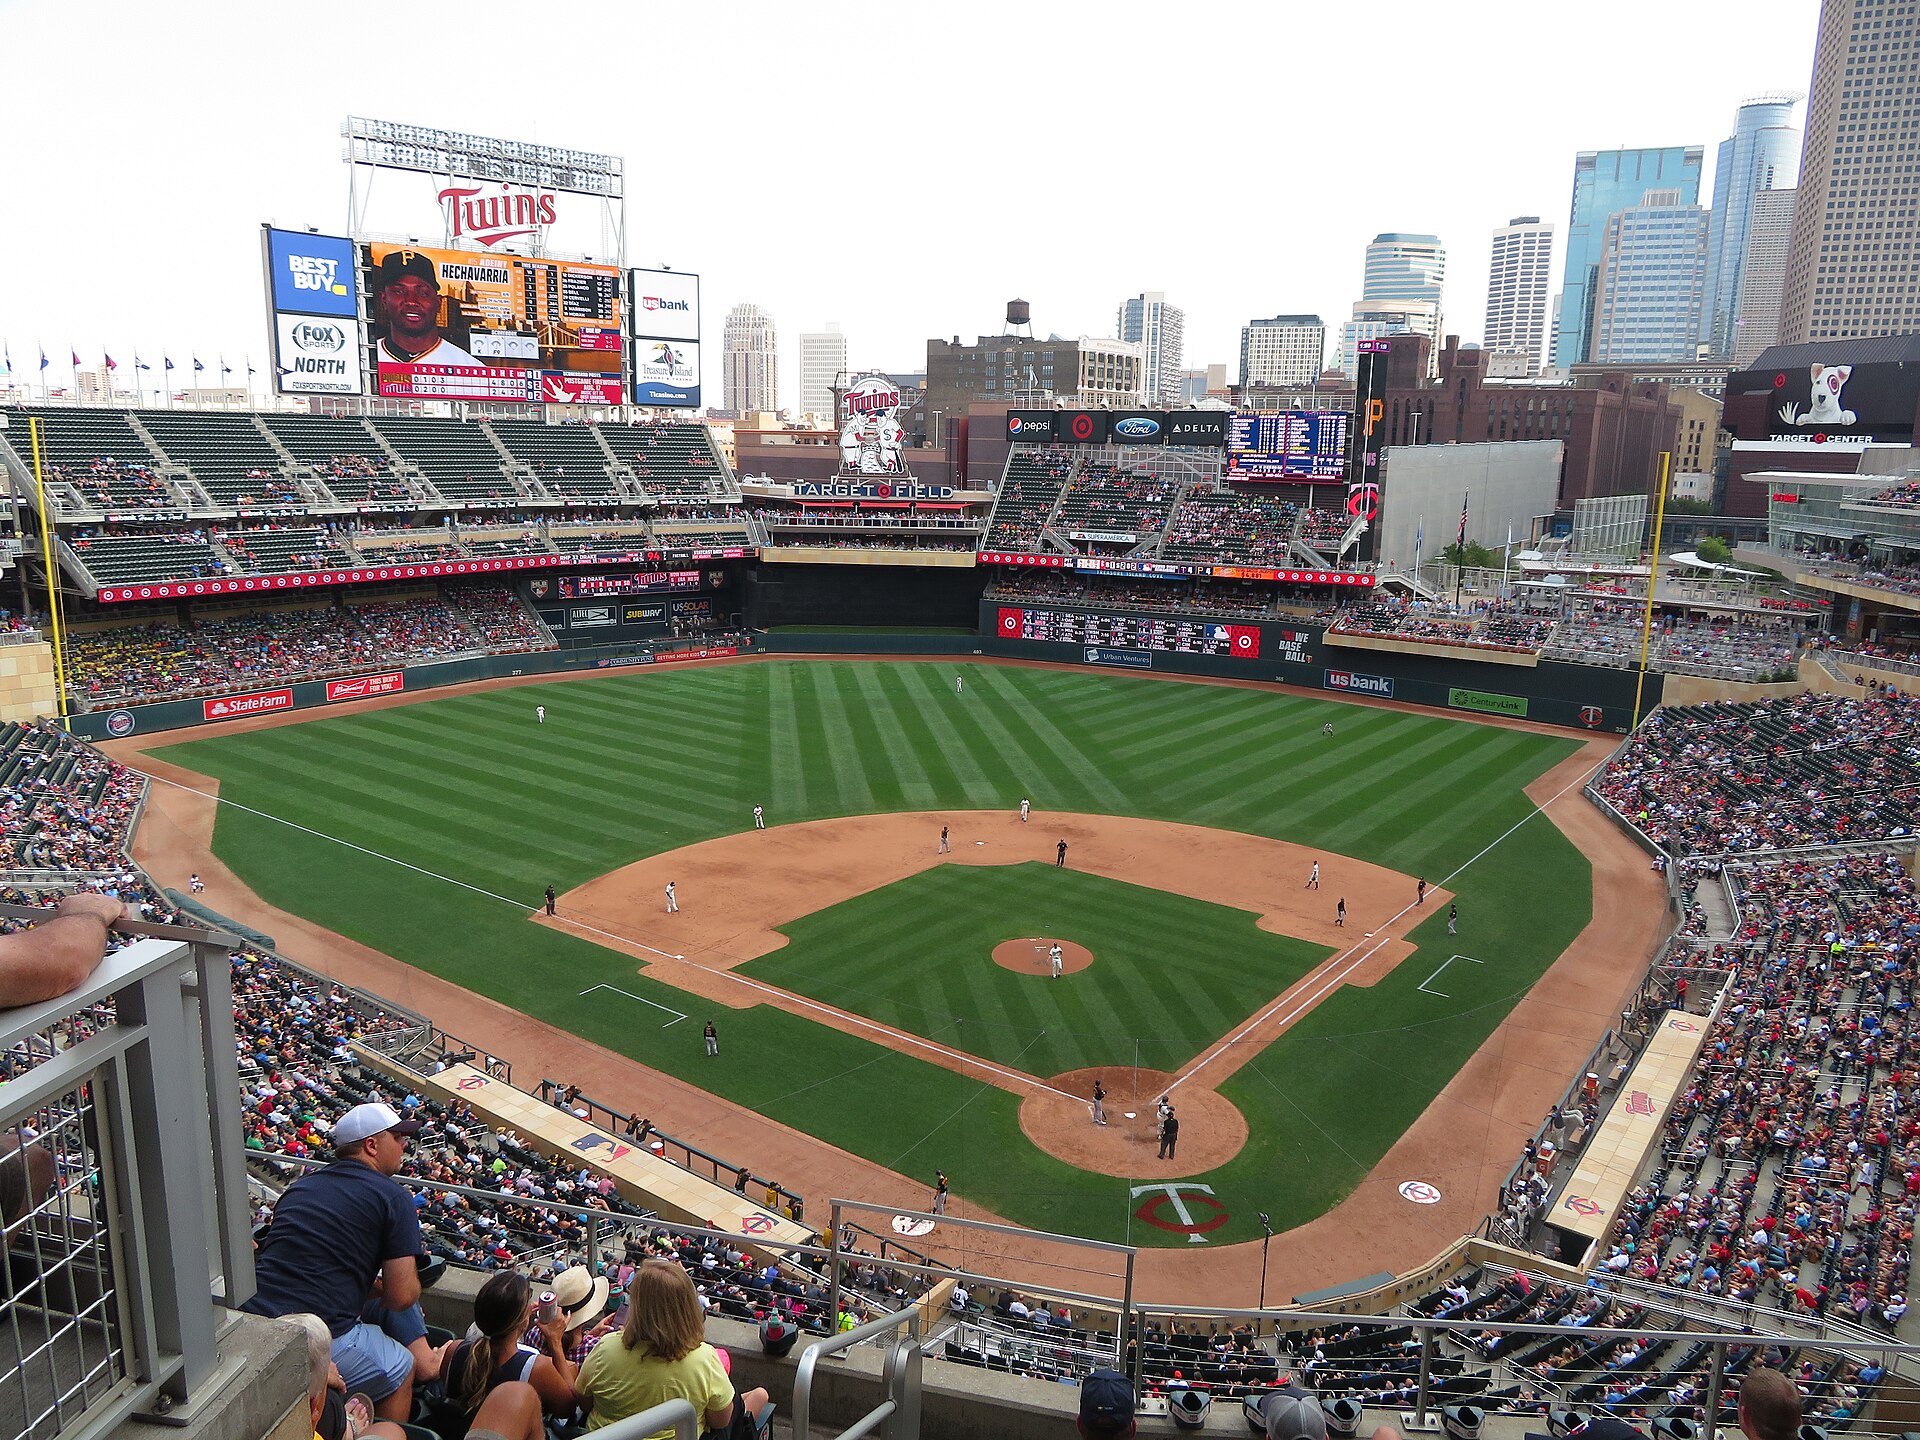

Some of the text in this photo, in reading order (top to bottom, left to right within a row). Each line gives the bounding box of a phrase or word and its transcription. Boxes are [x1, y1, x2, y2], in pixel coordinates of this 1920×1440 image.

[437, 183, 557, 241] Twins
[401, 250, 415, 266] P
[288, 254, 338, 276] BEST
[442, 264, 508, 283] HECHAVARRIA
[294, 272, 336, 292] BUY
[642, 297, 689, 311] usbank
[302, 326, 334, 342] FOX
[294, 356, 346, 374] NORTH
[642, 364, 692, 376] Treasure Island
[292, 382, 352, 391] FOXSPORTSNORTH.COM
[843, 389, 900, 415] Twins
[1364, 400, 1384, 436] P
[1024, 420, 1050, 432] pepsi
[1124, 420, 1151, 434] Ford
[1184, 424, 1220, 432] DELTA
[883, 429, 892, 441] S
[1769, 434, 1872, 444] TARGET CENTER
[794, 484, 954, 498] TARGET FIELD
[1087, 534, 1130, 542] SUPERAMERICA
[648, 552, 660, 560] 94
[626, 608, 662, 619] SUBWAY
[1295, 632, 1310, 643] WE
[1278, 640, 1302, 652] BASE
[610, 656, 641, 666] COMMUNITY
[1122, 655, 1150, 664] Ventures
[1285, 651, 1306, 664] BALL
[382, 675, 398, 683] BUD'S
[1330, 673, 1391, 692] usbank
[230, 694, 286, 712] State Farm
[1470, 696, 1519, 710] CenturyLink
[110, 718, 130, 730] Twins
